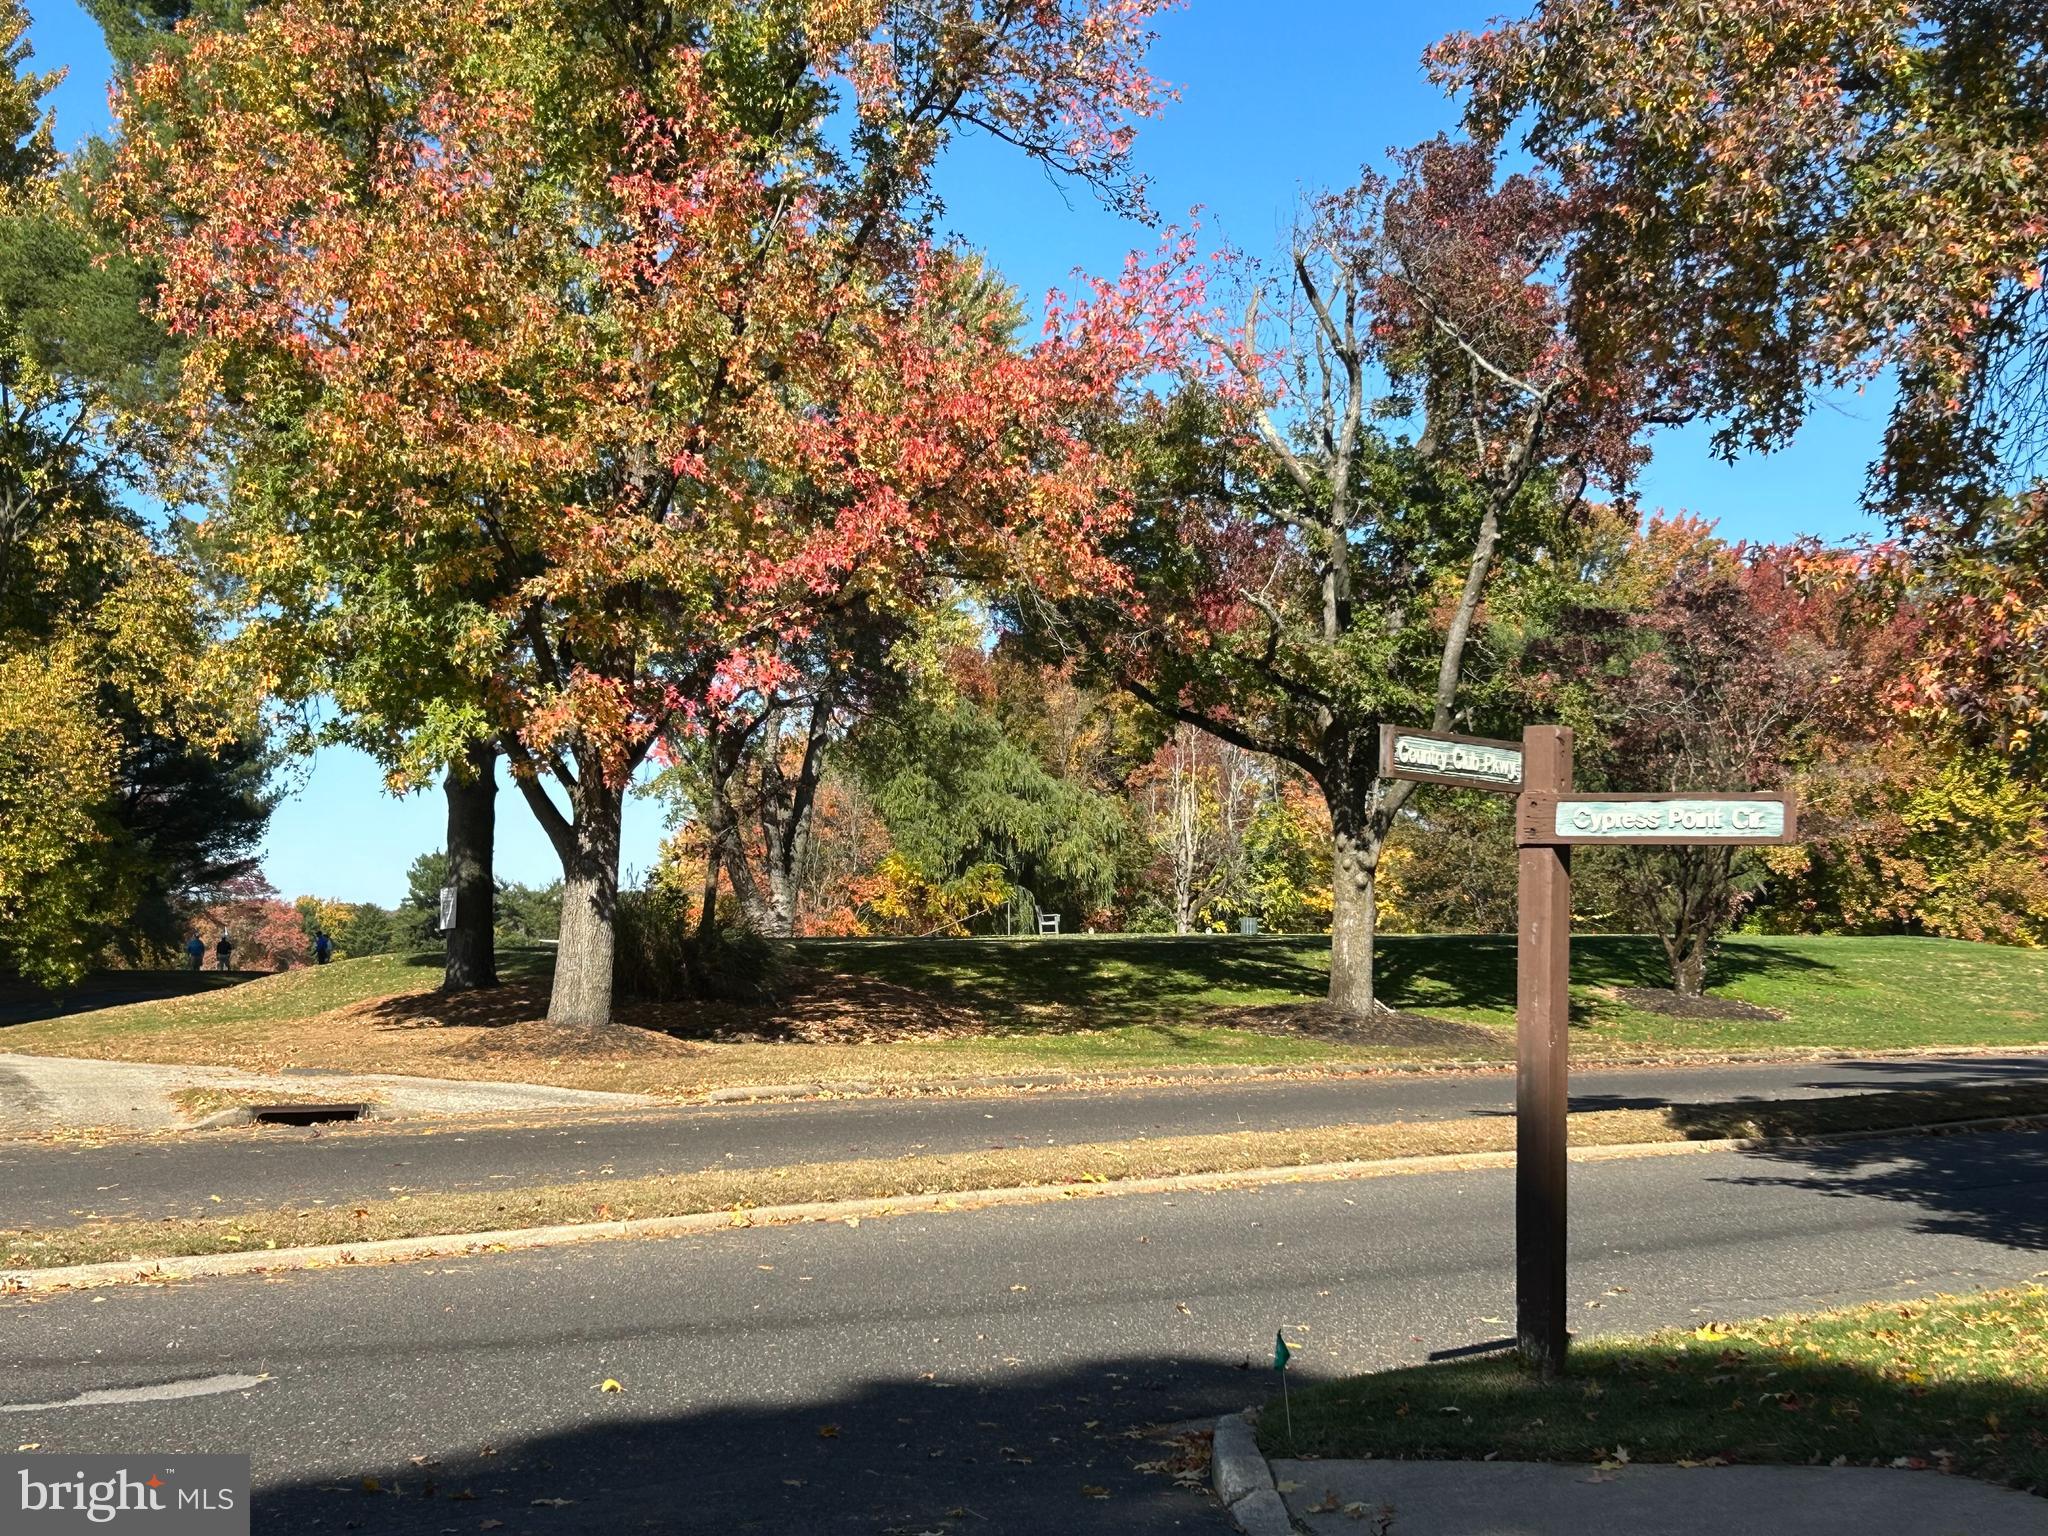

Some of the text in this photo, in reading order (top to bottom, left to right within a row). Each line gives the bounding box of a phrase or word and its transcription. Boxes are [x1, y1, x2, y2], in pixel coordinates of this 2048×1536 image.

[1397, 740, 1447, 771] Country
[1453, 748, 1479, 769] Club
[1573, 806, 1662, 833] Cypress
[1668, 806, 1723, 830] Point
